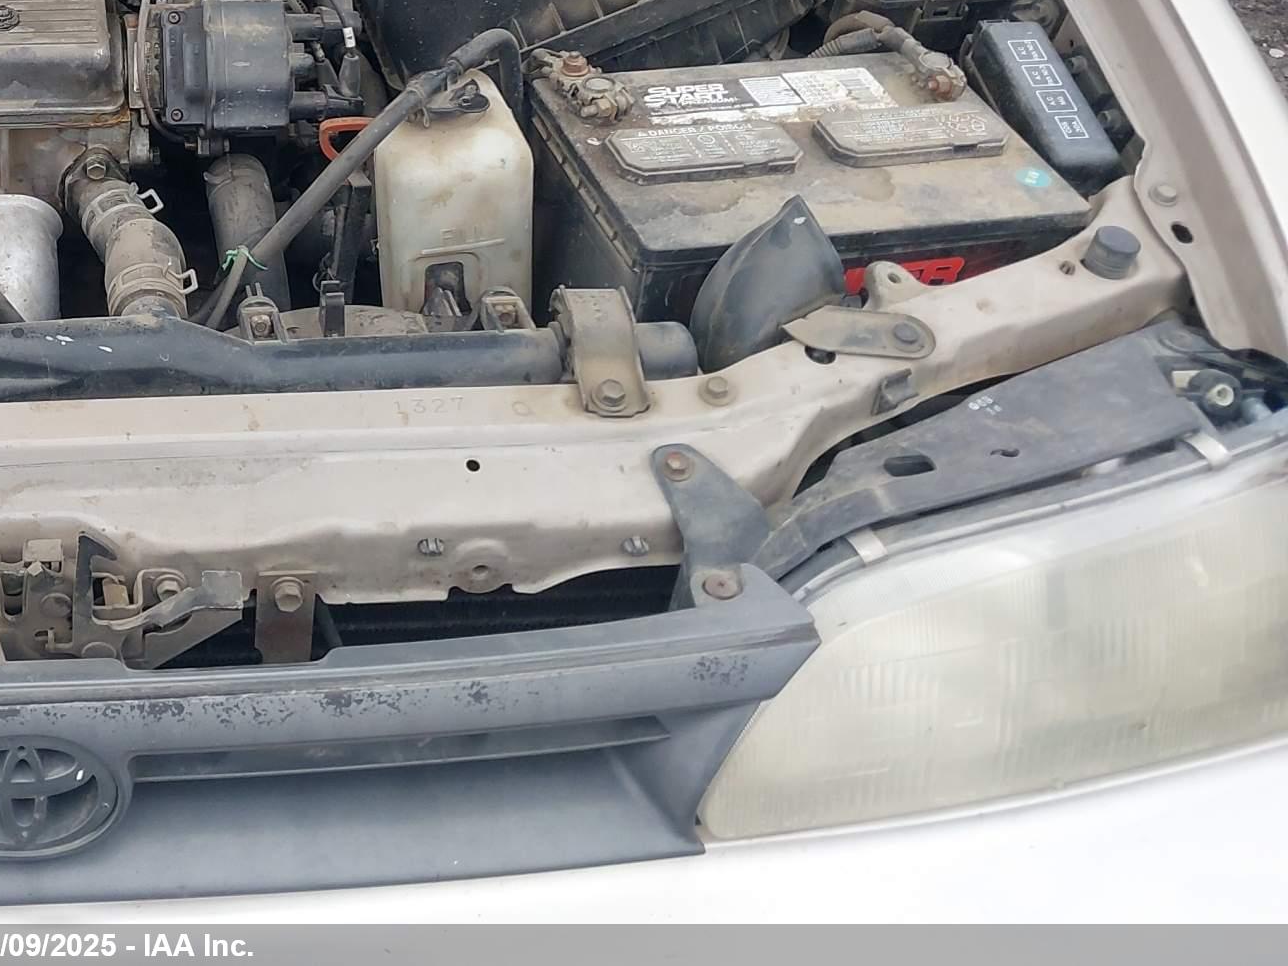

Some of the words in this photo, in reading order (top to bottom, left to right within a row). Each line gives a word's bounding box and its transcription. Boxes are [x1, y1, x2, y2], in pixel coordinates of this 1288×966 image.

[647, 83, 728, 95] SUPER
[643, 92, 728, 108] START
[647, 127, 697, 136] DANGER
[706, 123, 753, 132] POISON
